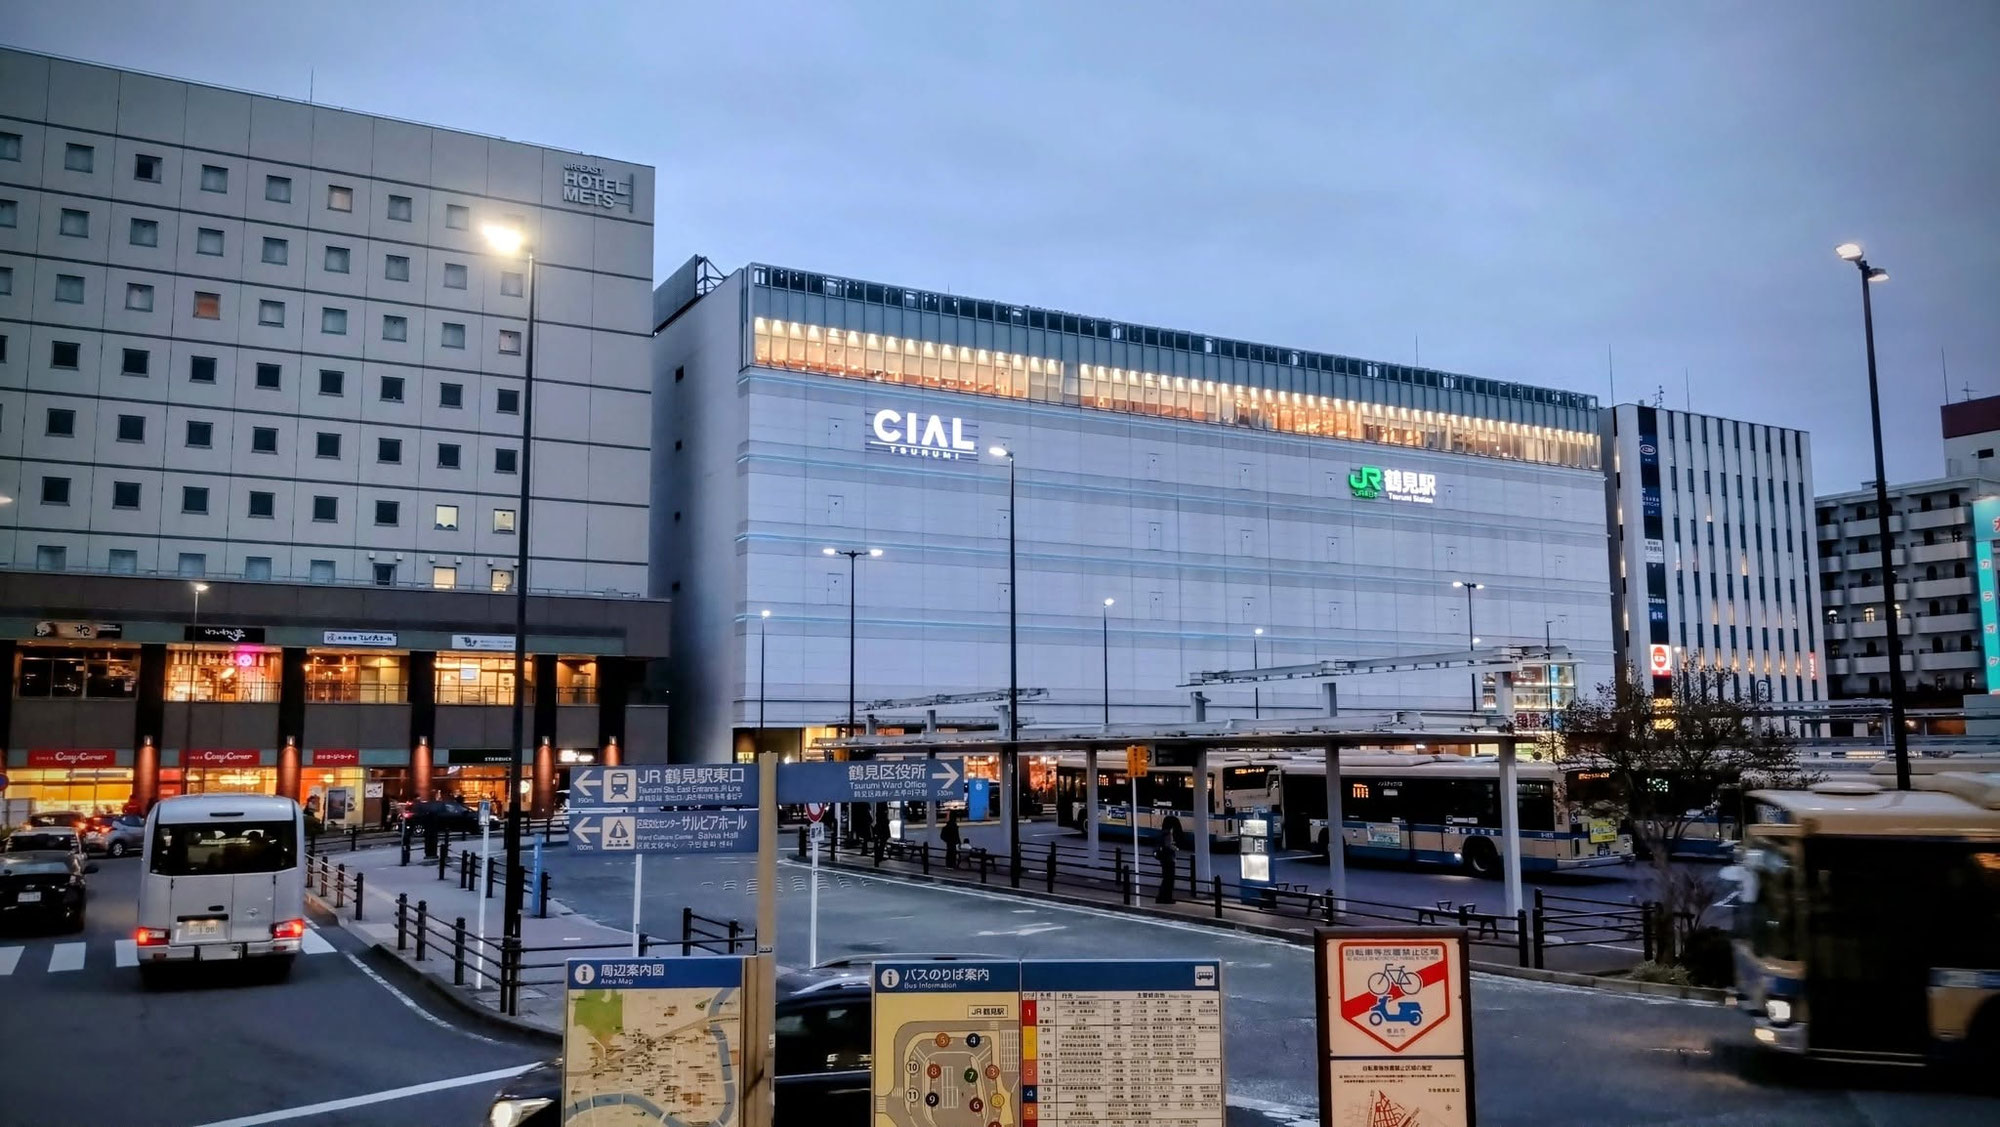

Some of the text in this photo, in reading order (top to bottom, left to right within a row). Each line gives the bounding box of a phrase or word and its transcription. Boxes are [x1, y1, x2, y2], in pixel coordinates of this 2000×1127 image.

[563, 171, 625, 194] HOTEL
[563, 185, 615, 208] METS
[873, 409, 975, 450] CIAL
[890, 446, 959, 460] TSURUMI
[1350, 466, 1381, 491] JR
[1384, 469, 1436, 496] 鶴見駅
[638, 768, 744, 784] JR 鶴見駅東口
[848, 763, 927, 781] 鶴見区役所
[638, 786, 662, 794] Tsurumi
[849, 781, 927, 790] Tsurumi Ward Office
[698, 831, 721, 840] Salvia
[723, 831, 739, 839] Hall
[1345, 949, 1440, 957] 自転車等放置禁止区域
[600, 964, 664, 977] 周辺案内図
[904, 968, 989, 981] バスのりば案内
